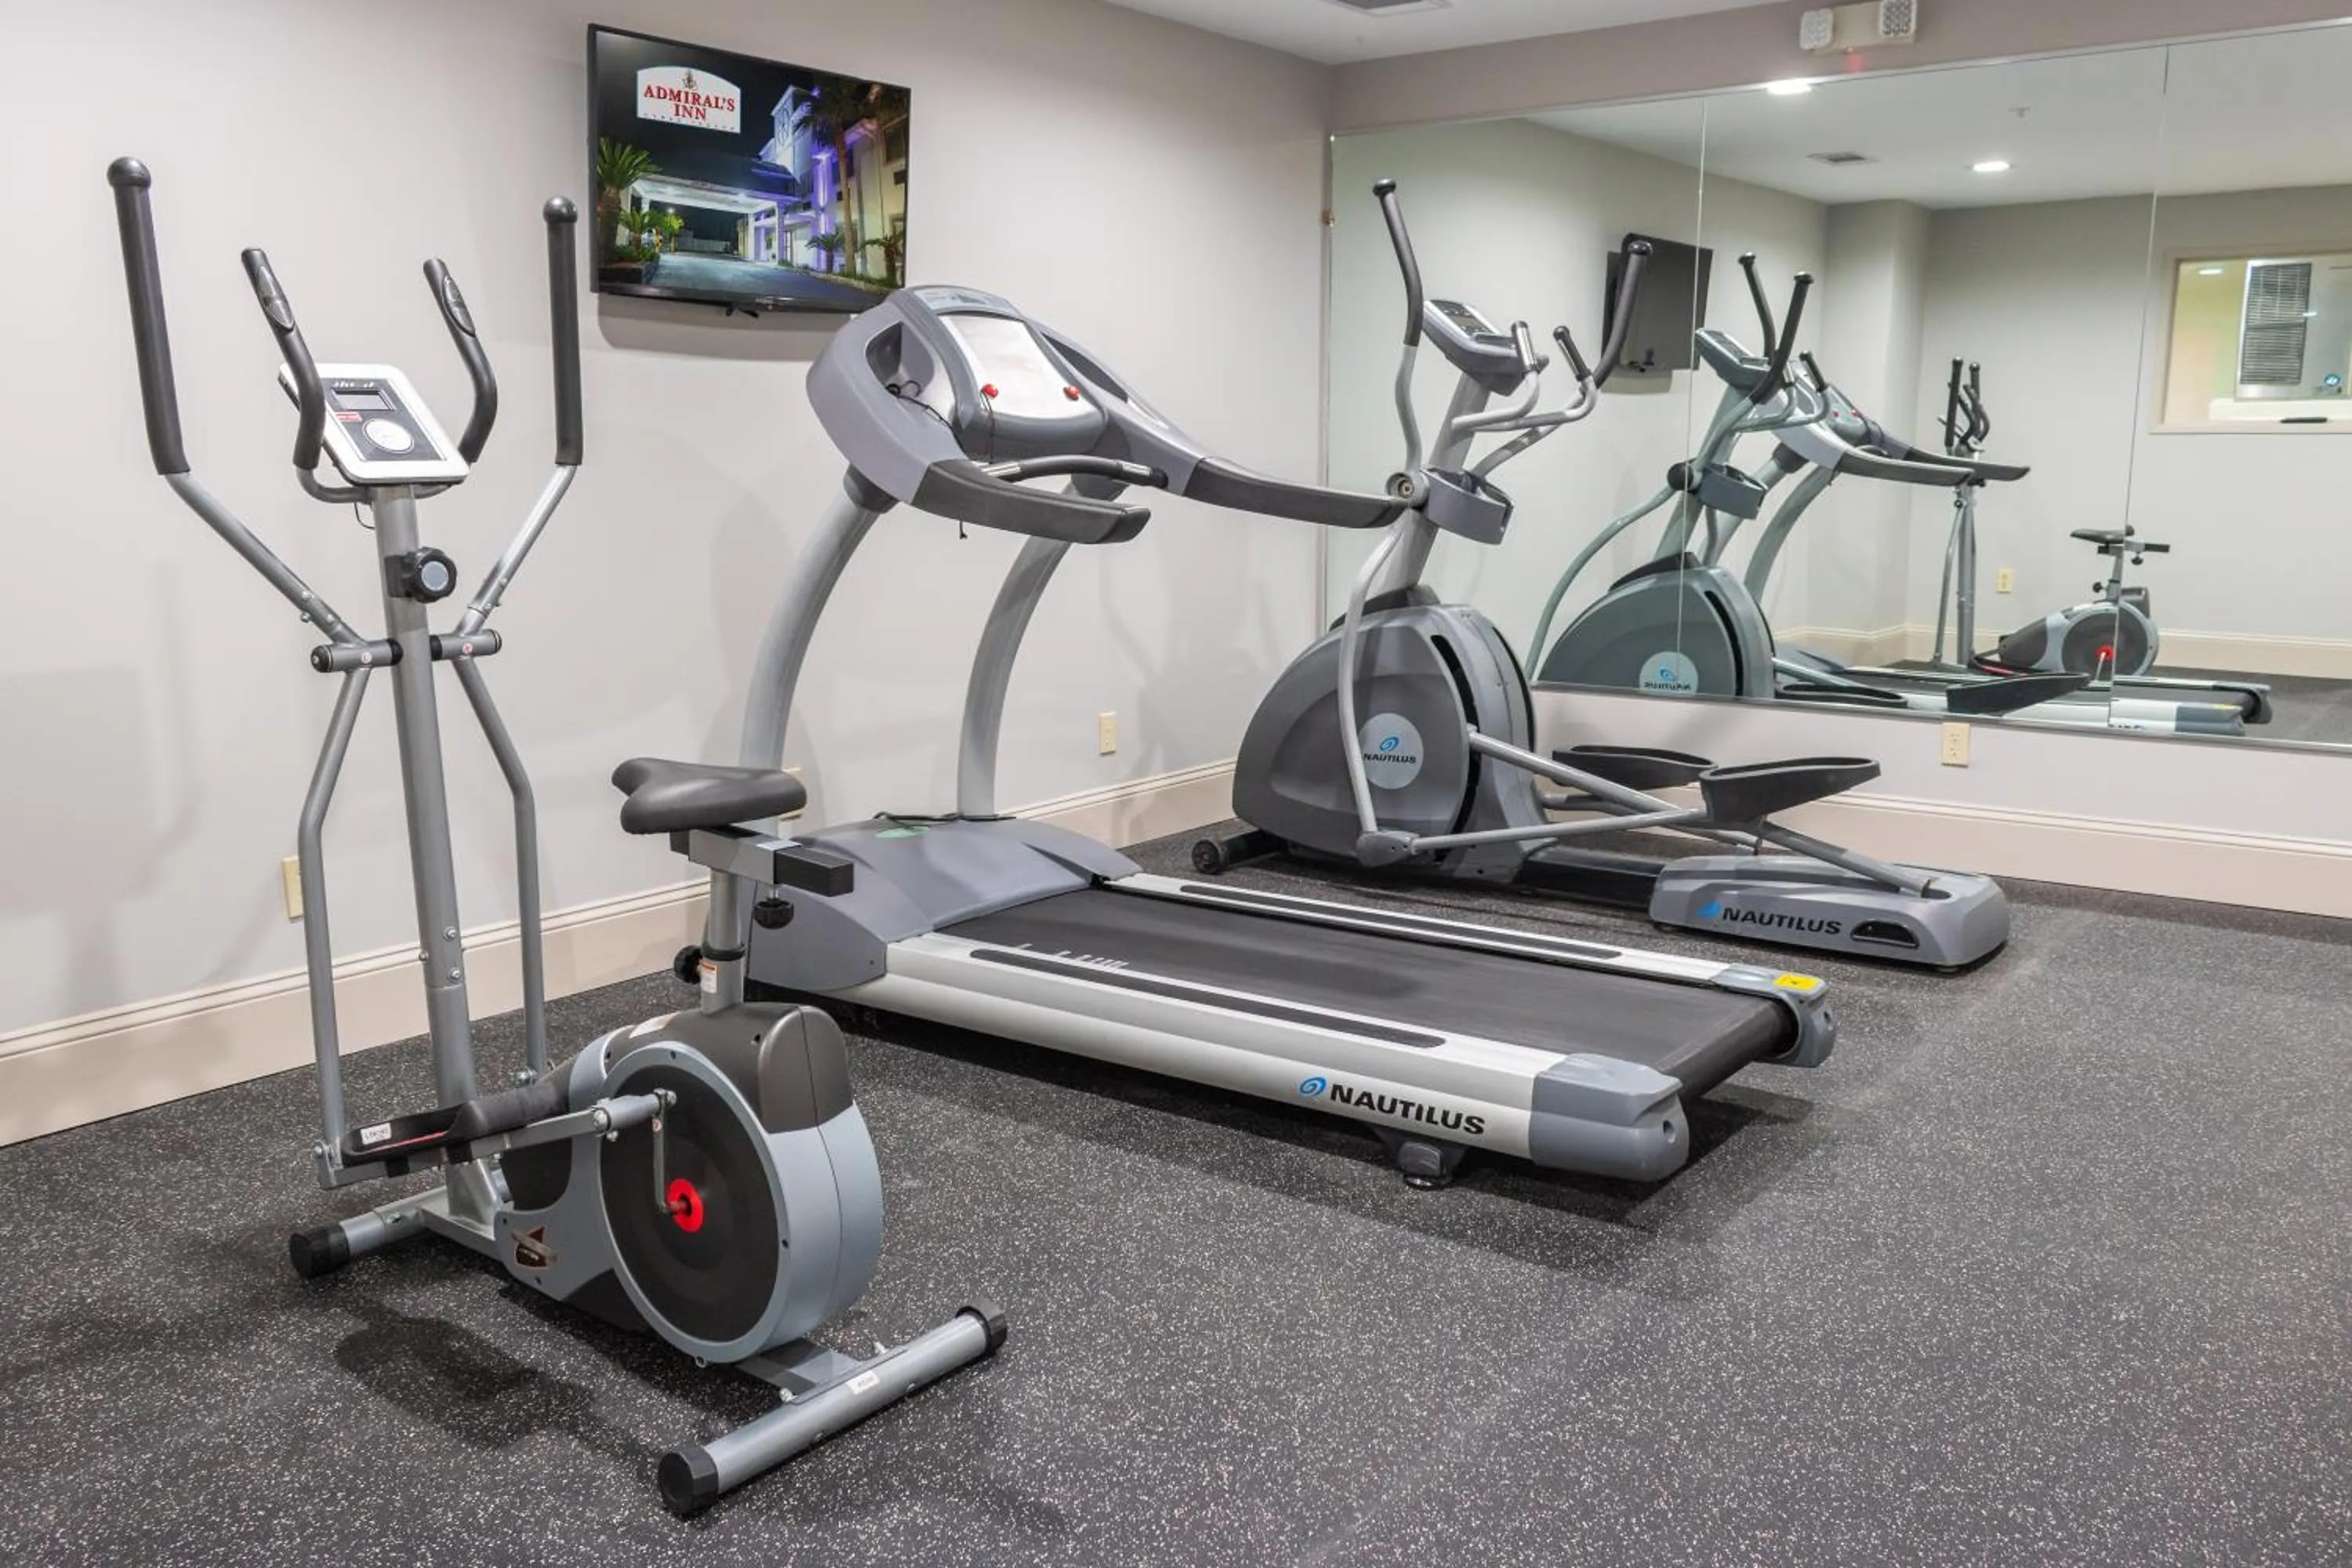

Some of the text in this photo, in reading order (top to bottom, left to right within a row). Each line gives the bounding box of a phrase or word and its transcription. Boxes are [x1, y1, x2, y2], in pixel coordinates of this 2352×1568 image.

[643, 84, 735, 112] ADMIRAL'S
[674, 103, 706, 120] INN
[1363, 753, 1417, 764] NAUTILUS
[1722, 907, 1842, 935] NAUTILUS
[1330, 1083, 1485, 1135] NAUTILUS
